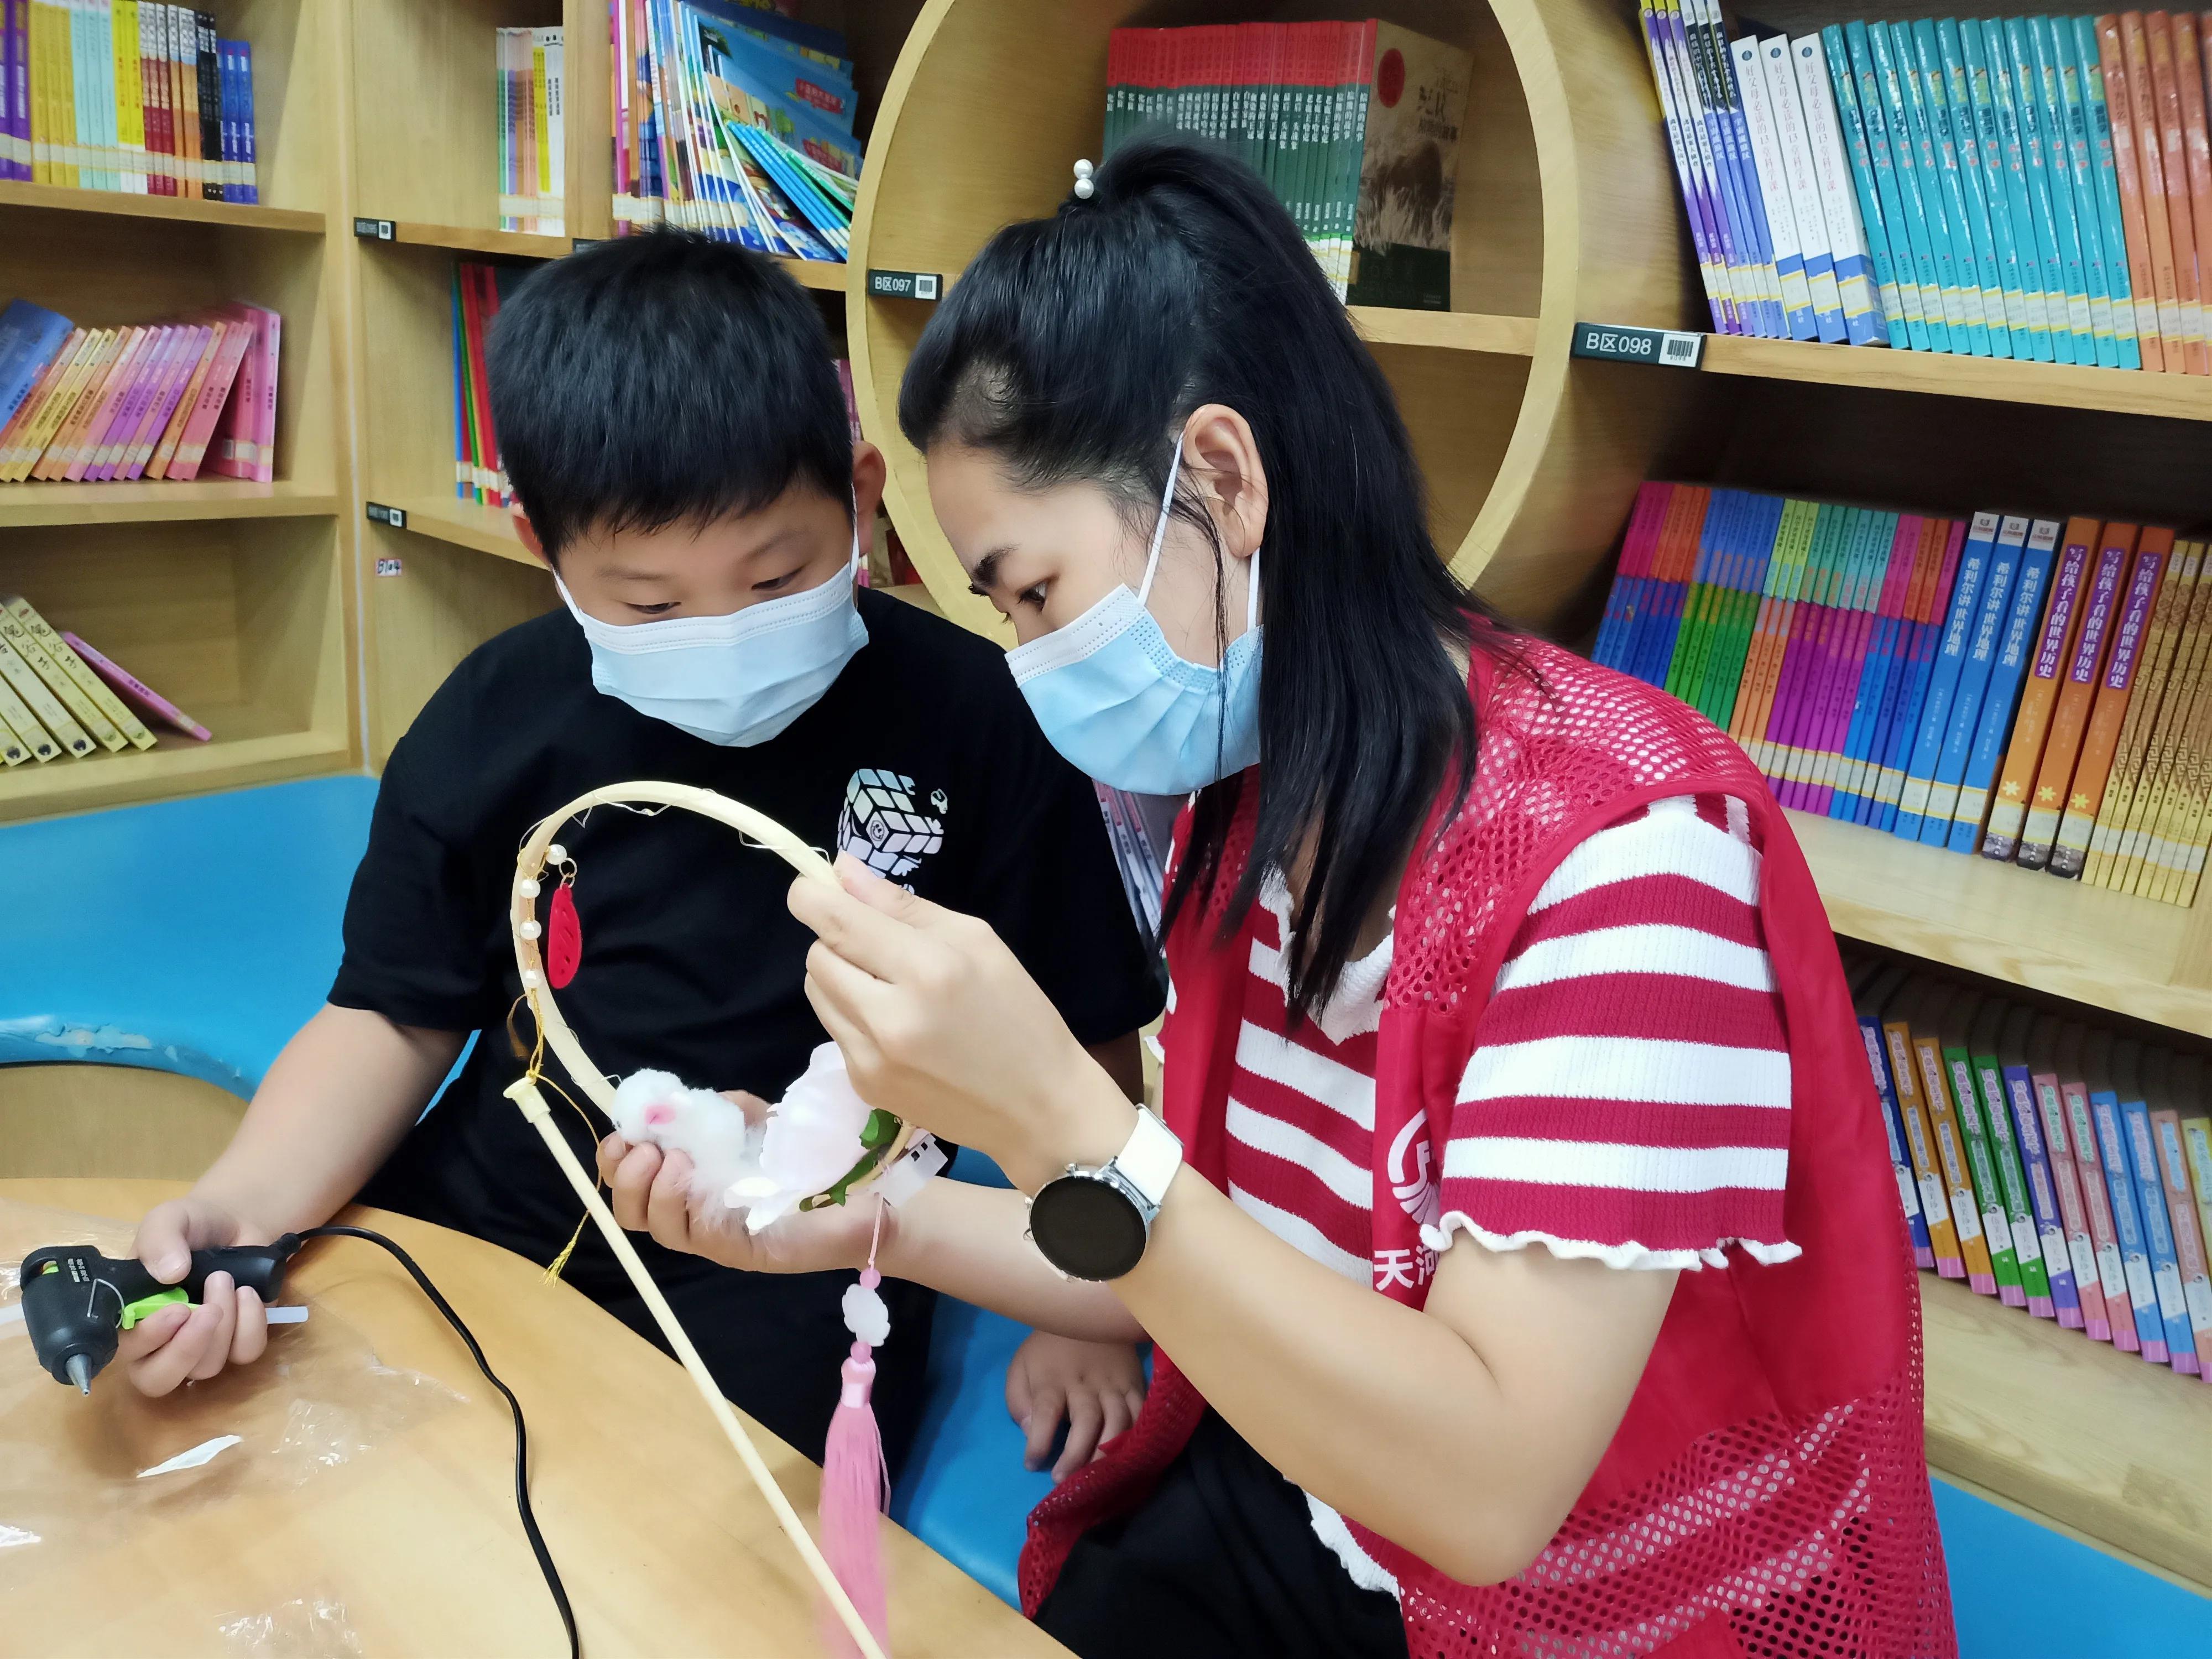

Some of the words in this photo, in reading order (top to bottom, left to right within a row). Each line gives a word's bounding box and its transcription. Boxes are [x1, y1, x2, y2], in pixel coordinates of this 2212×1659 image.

[875, 276, 911, 292] B区097
[1585, 332, 1652, 355] B区098
[1944, 557, 1981, 656] 希利尔讲世界地理
[1973, 562, 2010, 661] 希利尔讲世界地理
[2002, 566, 2041, 667] 希利尔讲世界地理
[2039, 547, 2084, 677] 写给孩子看的世界历史
[2075, 551, 2121, 682] 写给孩子看的世界历史
[2110, 556, 2158, 688] 写给孩子看的世界历史
